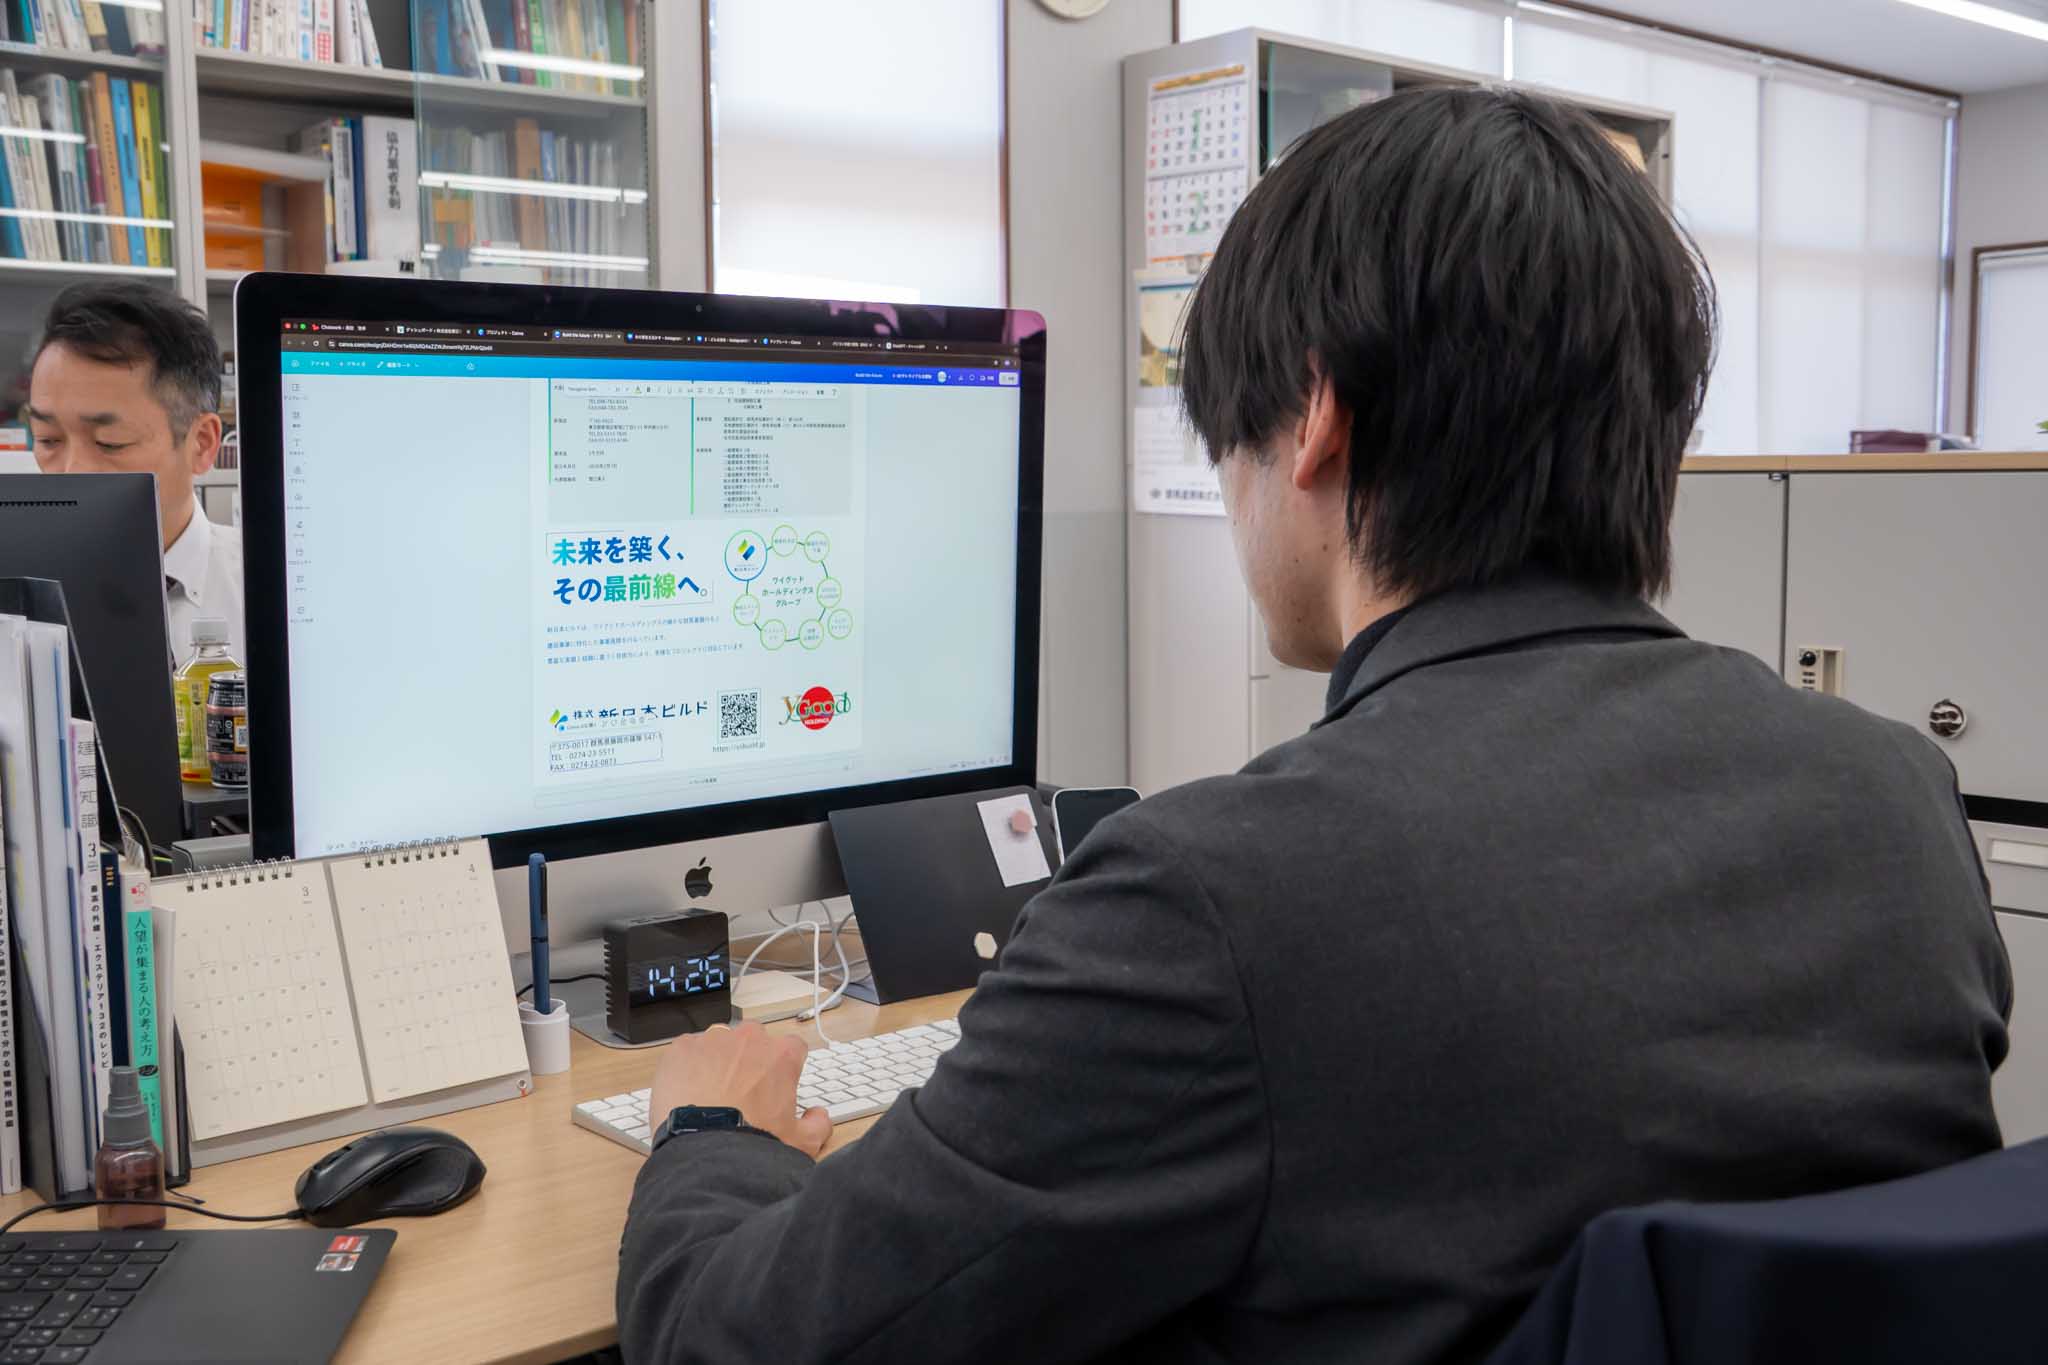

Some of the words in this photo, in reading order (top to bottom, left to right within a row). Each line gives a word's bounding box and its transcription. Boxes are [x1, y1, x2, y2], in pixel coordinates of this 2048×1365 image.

[551, 533, 687, 567] 未来を築く、
[552, 572, 708, 605] その最前線へ。
[761, 586, 815, 597] ホールディングス
[775, 599, 801, 608] グループ
[134, 915, 153, 1057] 人望が集まる人の考え方
